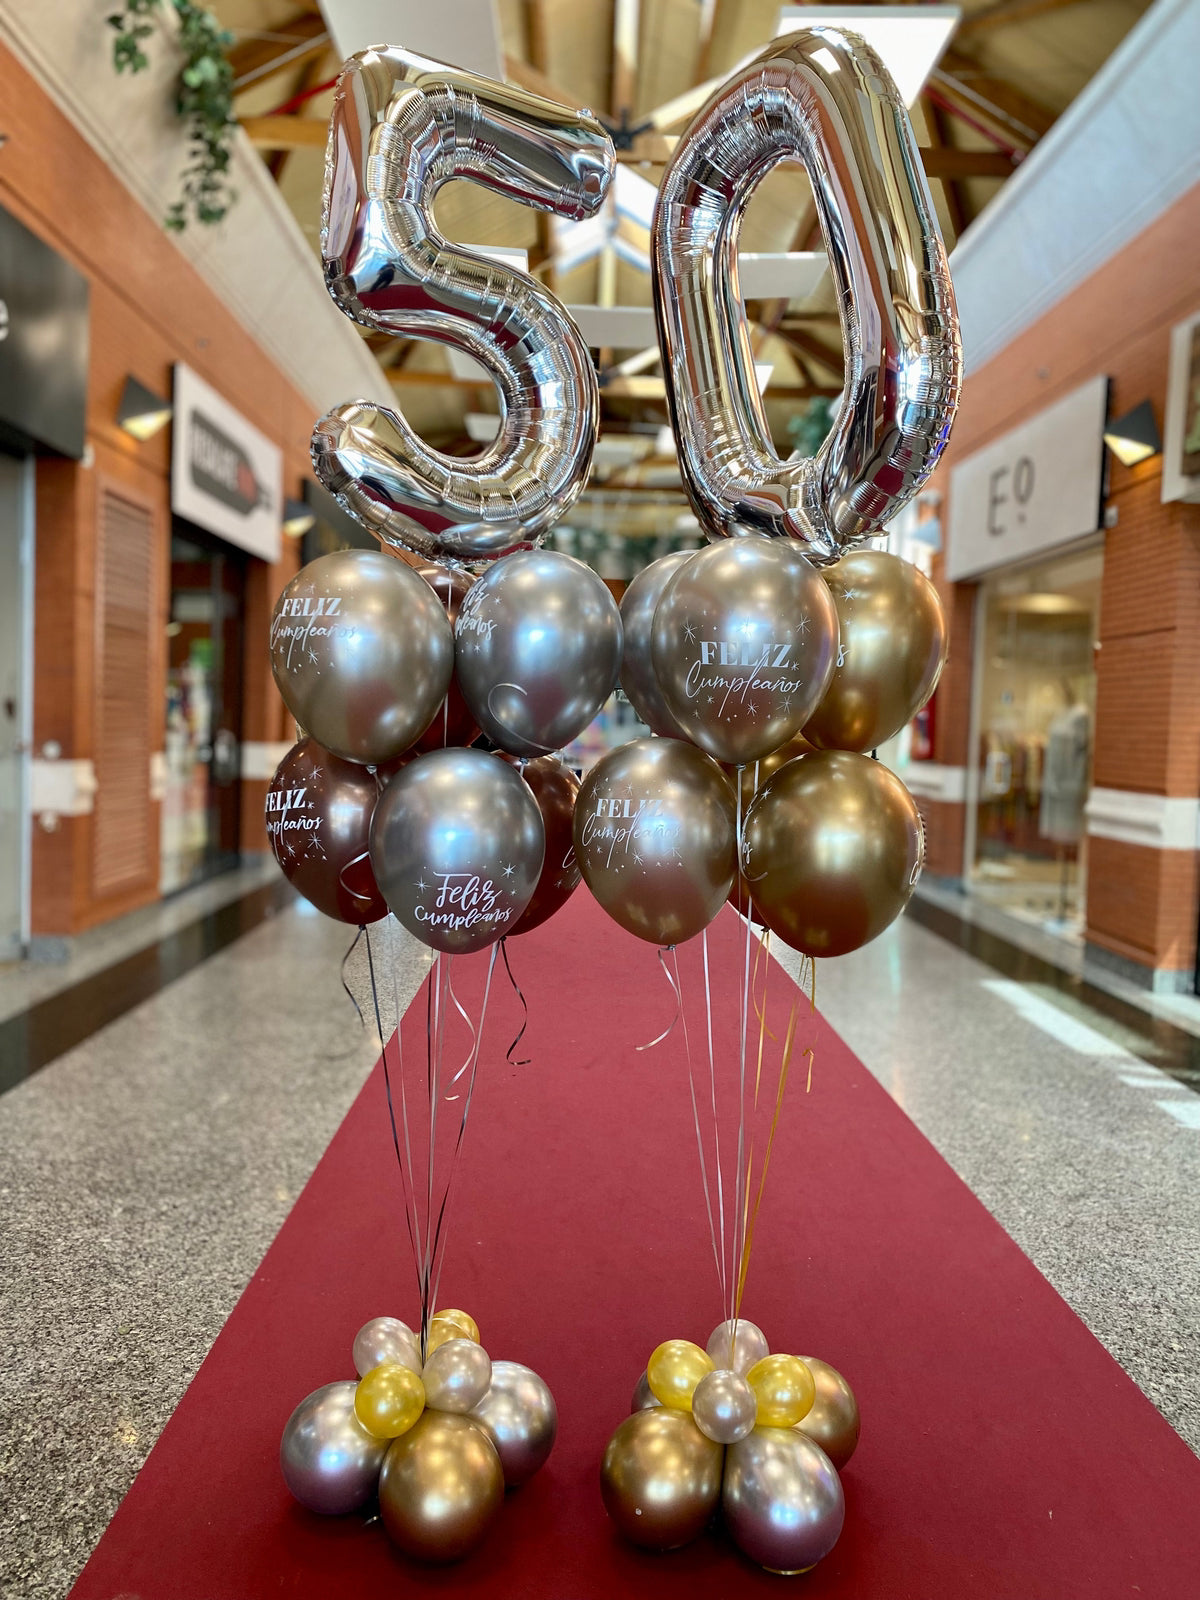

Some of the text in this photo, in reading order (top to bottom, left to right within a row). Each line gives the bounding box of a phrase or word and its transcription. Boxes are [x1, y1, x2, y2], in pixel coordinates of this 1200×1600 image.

[281, 597, 342, 617] FELIZ
[700, 641, 792, 668] FELIZ
[685, 651, 803, 718] Cumpleaños
[595, 798, 665, 818] FELIZ
[433, 871, 503, 912] Feliz
[414, 905, 514, 931] Cumpleaños
